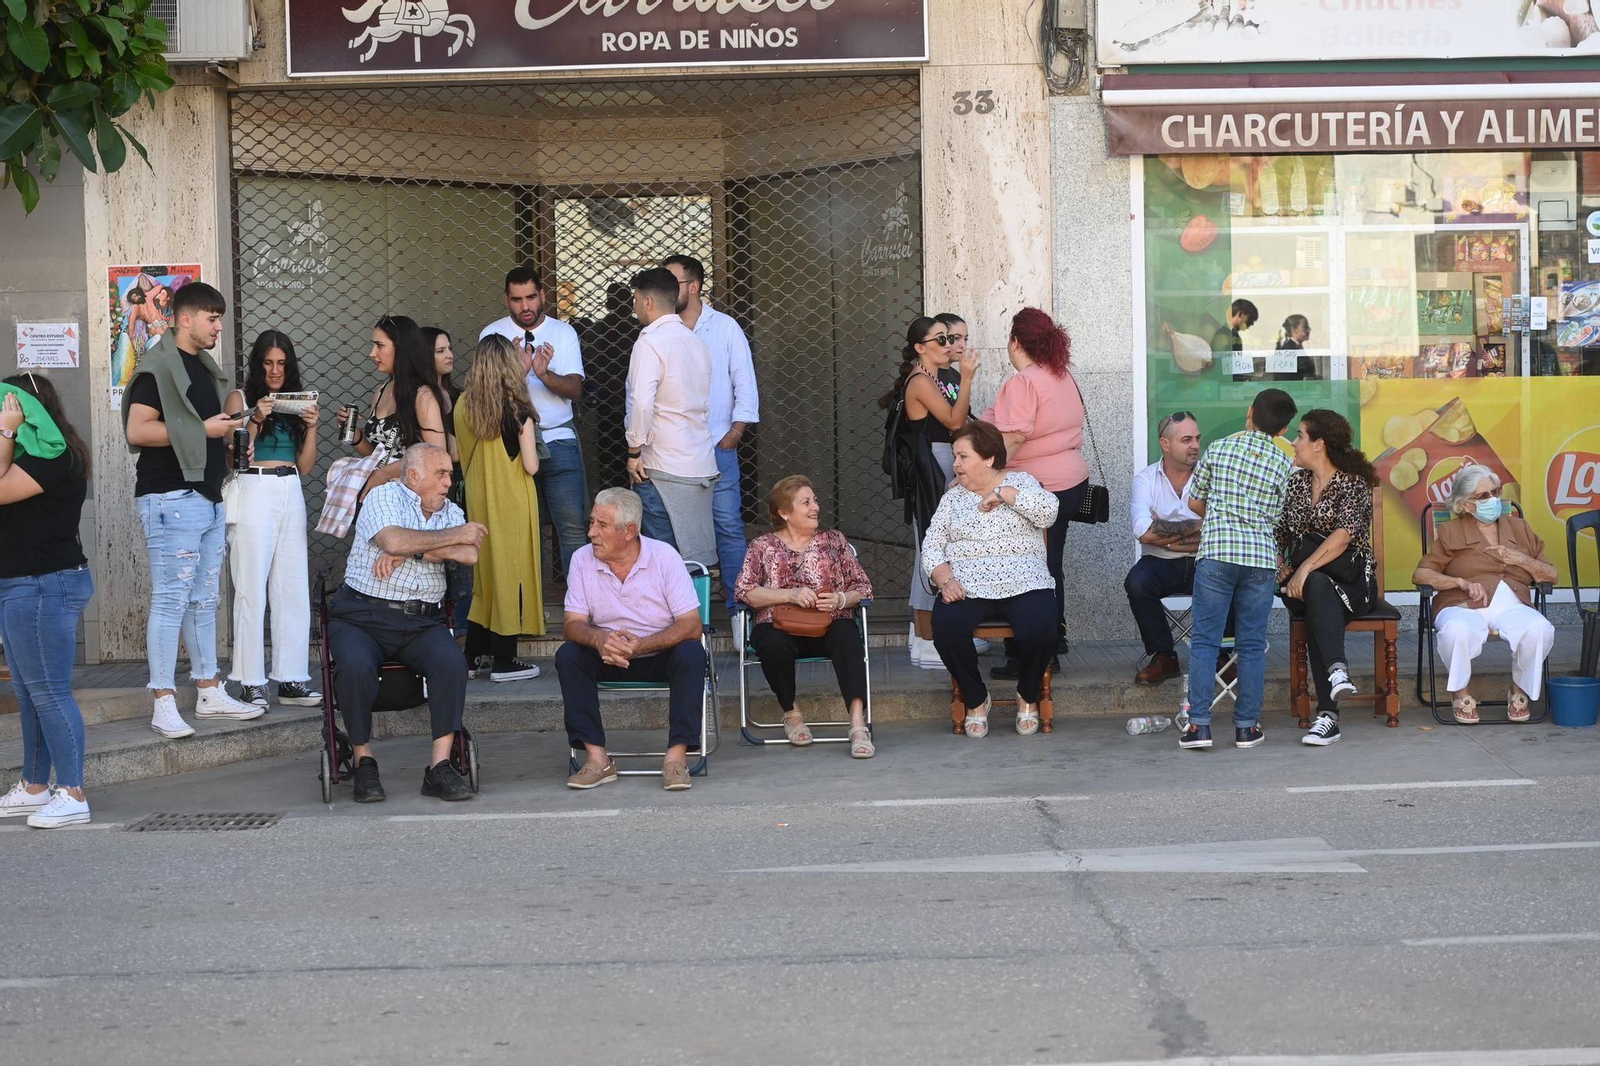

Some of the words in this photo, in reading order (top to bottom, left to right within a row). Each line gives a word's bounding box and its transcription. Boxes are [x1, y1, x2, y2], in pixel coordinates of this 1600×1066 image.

[602, 31, 671, 51] ROPA
[680, 30, 709, 50] DE
[720, 22, 798, 48] NIÑOS
[952, 90, 995, 115] 33
[1161, 103, 1432, 148] CHARCUTERÍA
[1439, 110, 1465, 145] Y
[1477, 107, 1600, 144] ALIME
[1554, 454, 1600, 505] La
